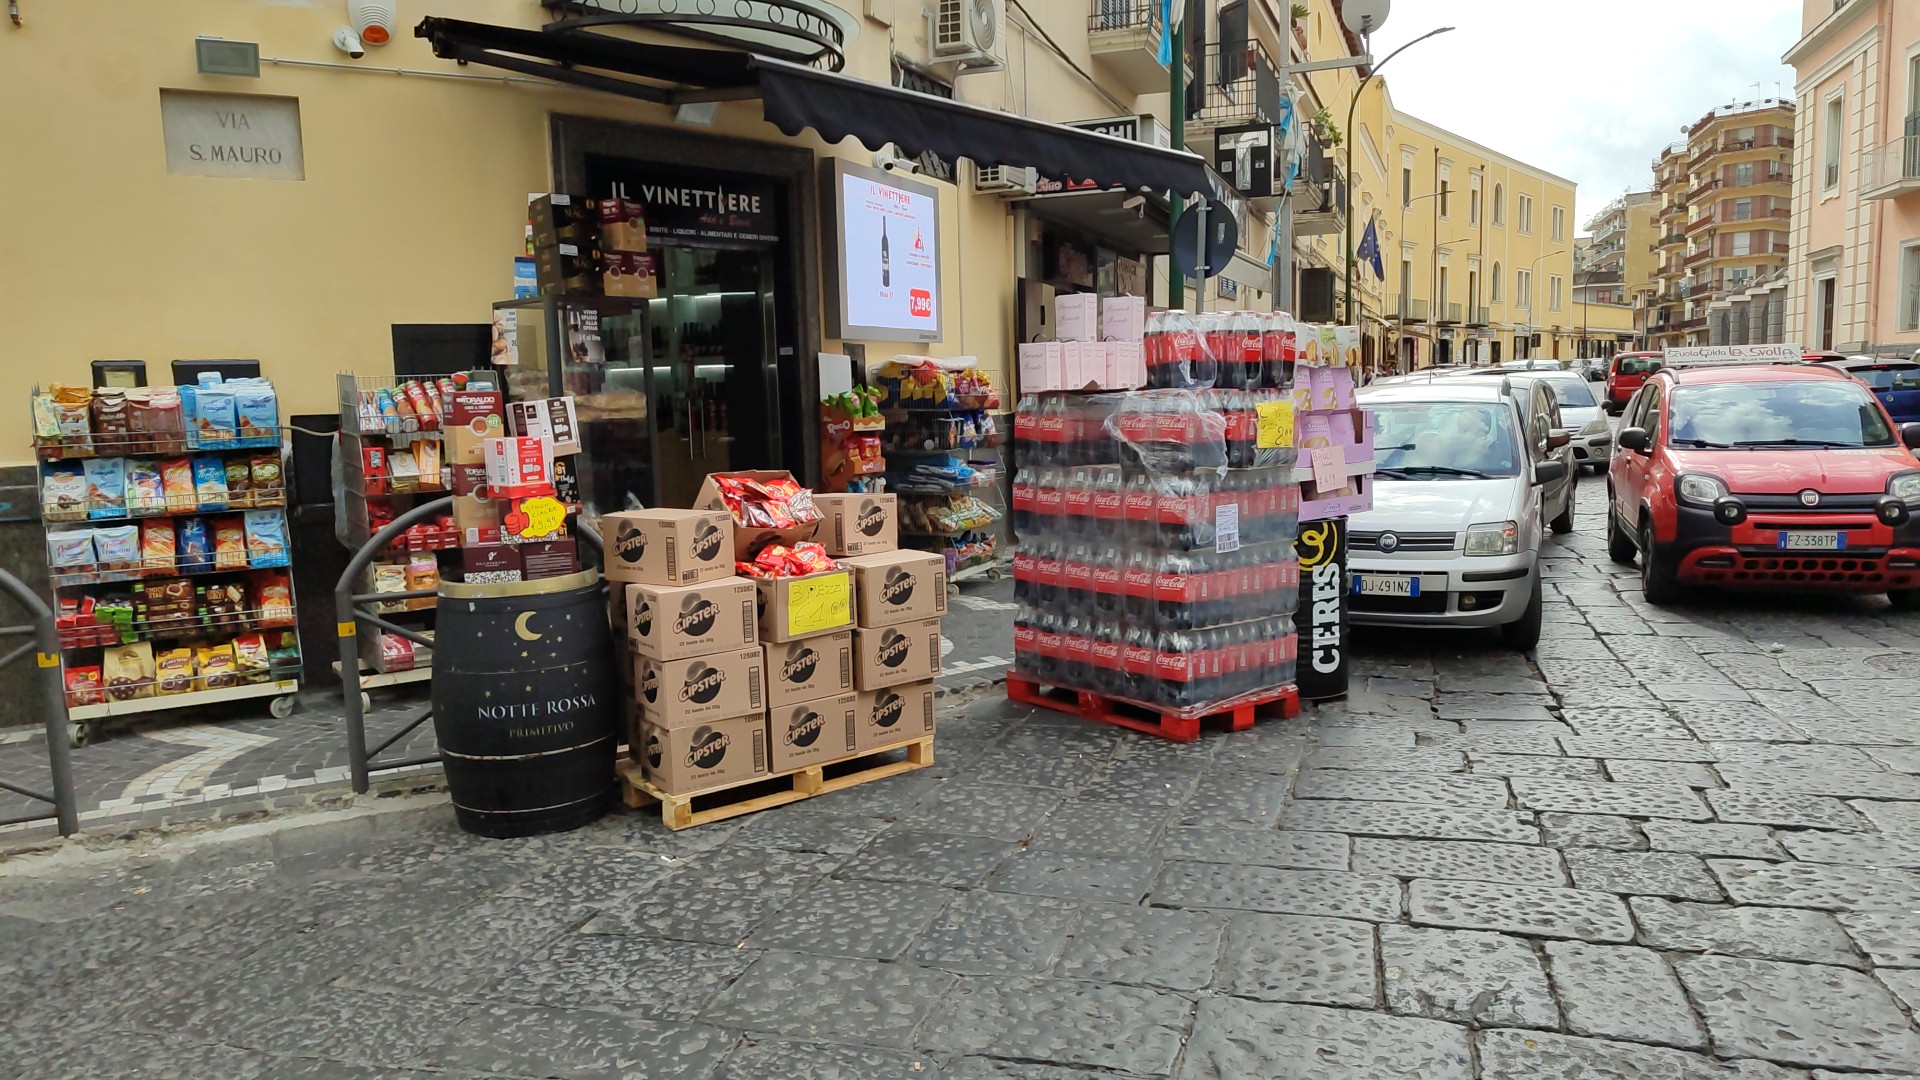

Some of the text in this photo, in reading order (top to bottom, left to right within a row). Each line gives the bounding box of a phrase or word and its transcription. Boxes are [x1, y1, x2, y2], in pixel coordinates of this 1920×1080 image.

[216, 112, 251, 129] VIA
[190, 144, 282, 165] S. MAURO
[612, 181, 630, 200] IL
[700, 230, 733, 239] ALIMENTARI
[910, 296, 931, 312] 7,99€
[1668, 349, 1699, 358] Scuola
[792, 583, 846, 603] 3 PEZZI
[1312, 563, 1340, 674] CERES
[478, 694, 596, 719] NOTTE ROSSA
[509, 721, 574, 738] PRIMITIVO
